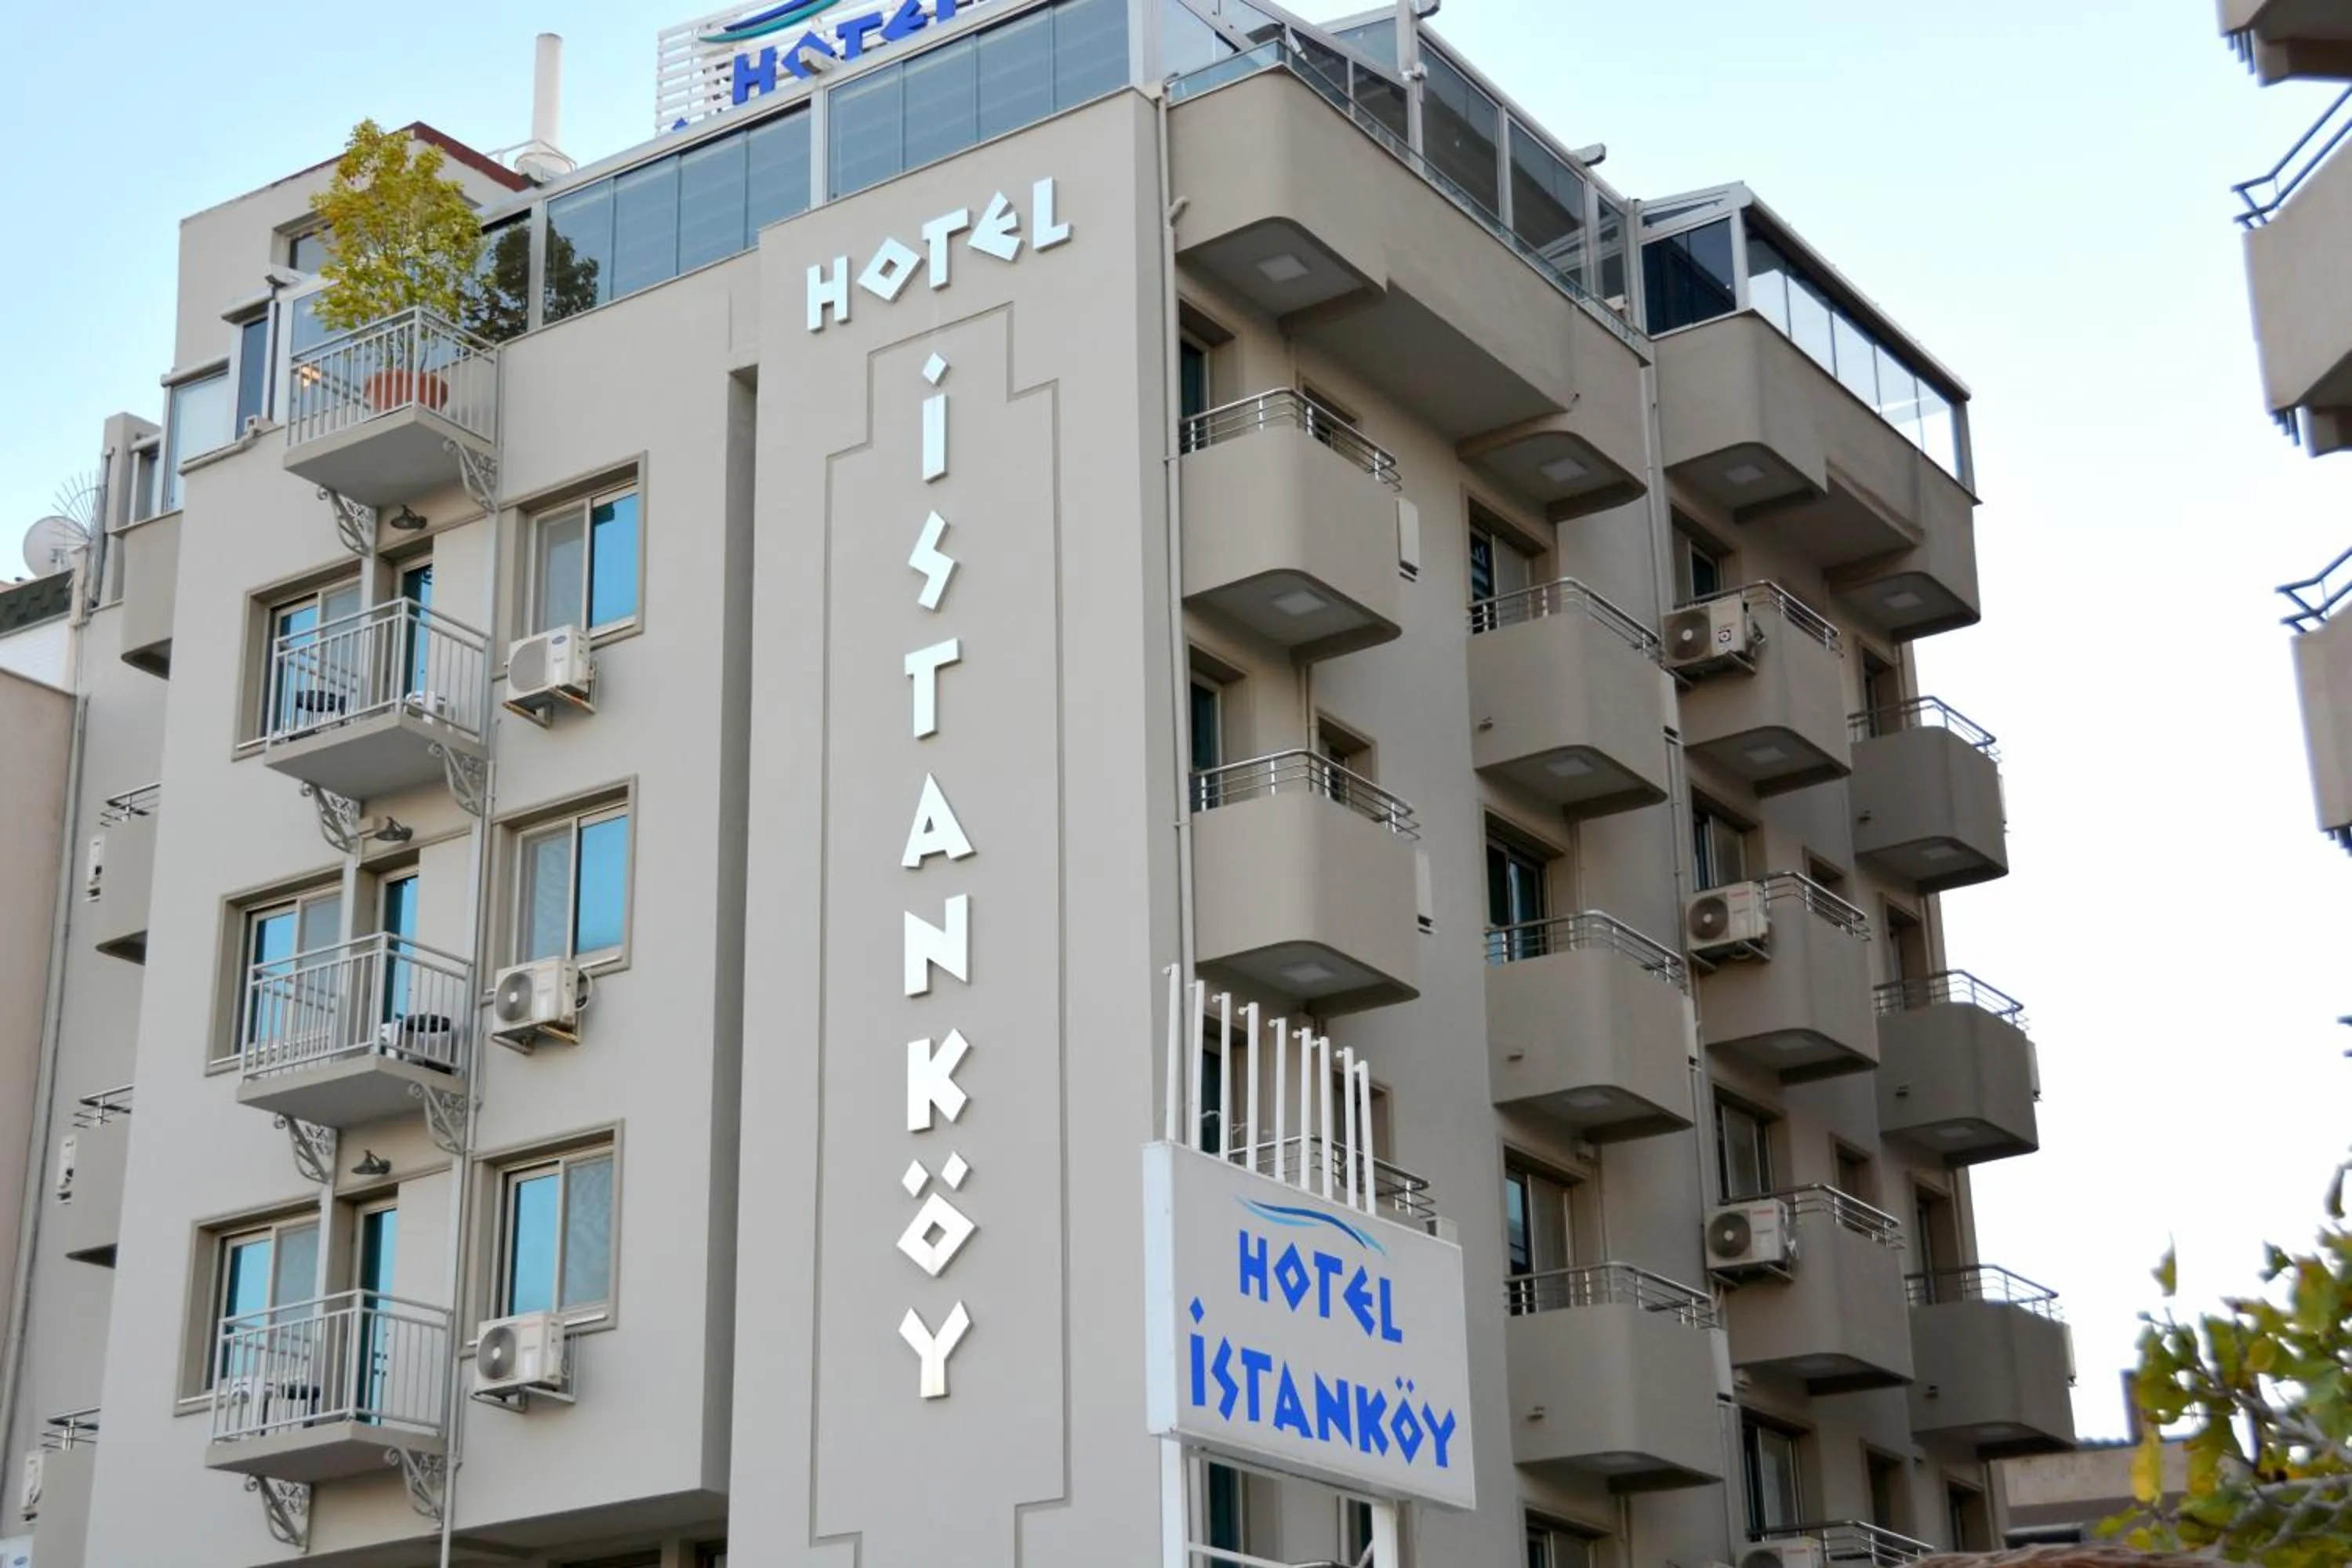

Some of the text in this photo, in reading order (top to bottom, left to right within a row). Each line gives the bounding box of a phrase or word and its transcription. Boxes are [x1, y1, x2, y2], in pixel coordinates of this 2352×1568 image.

[806, 176, 1073, 333] HOTEL
[898, 352, 975, 1398] İSTANKÖY
[1239, 1229, 1403, 1344] HOTEL
[1189, 1296, 1457, 1468] İSTANKÖY
